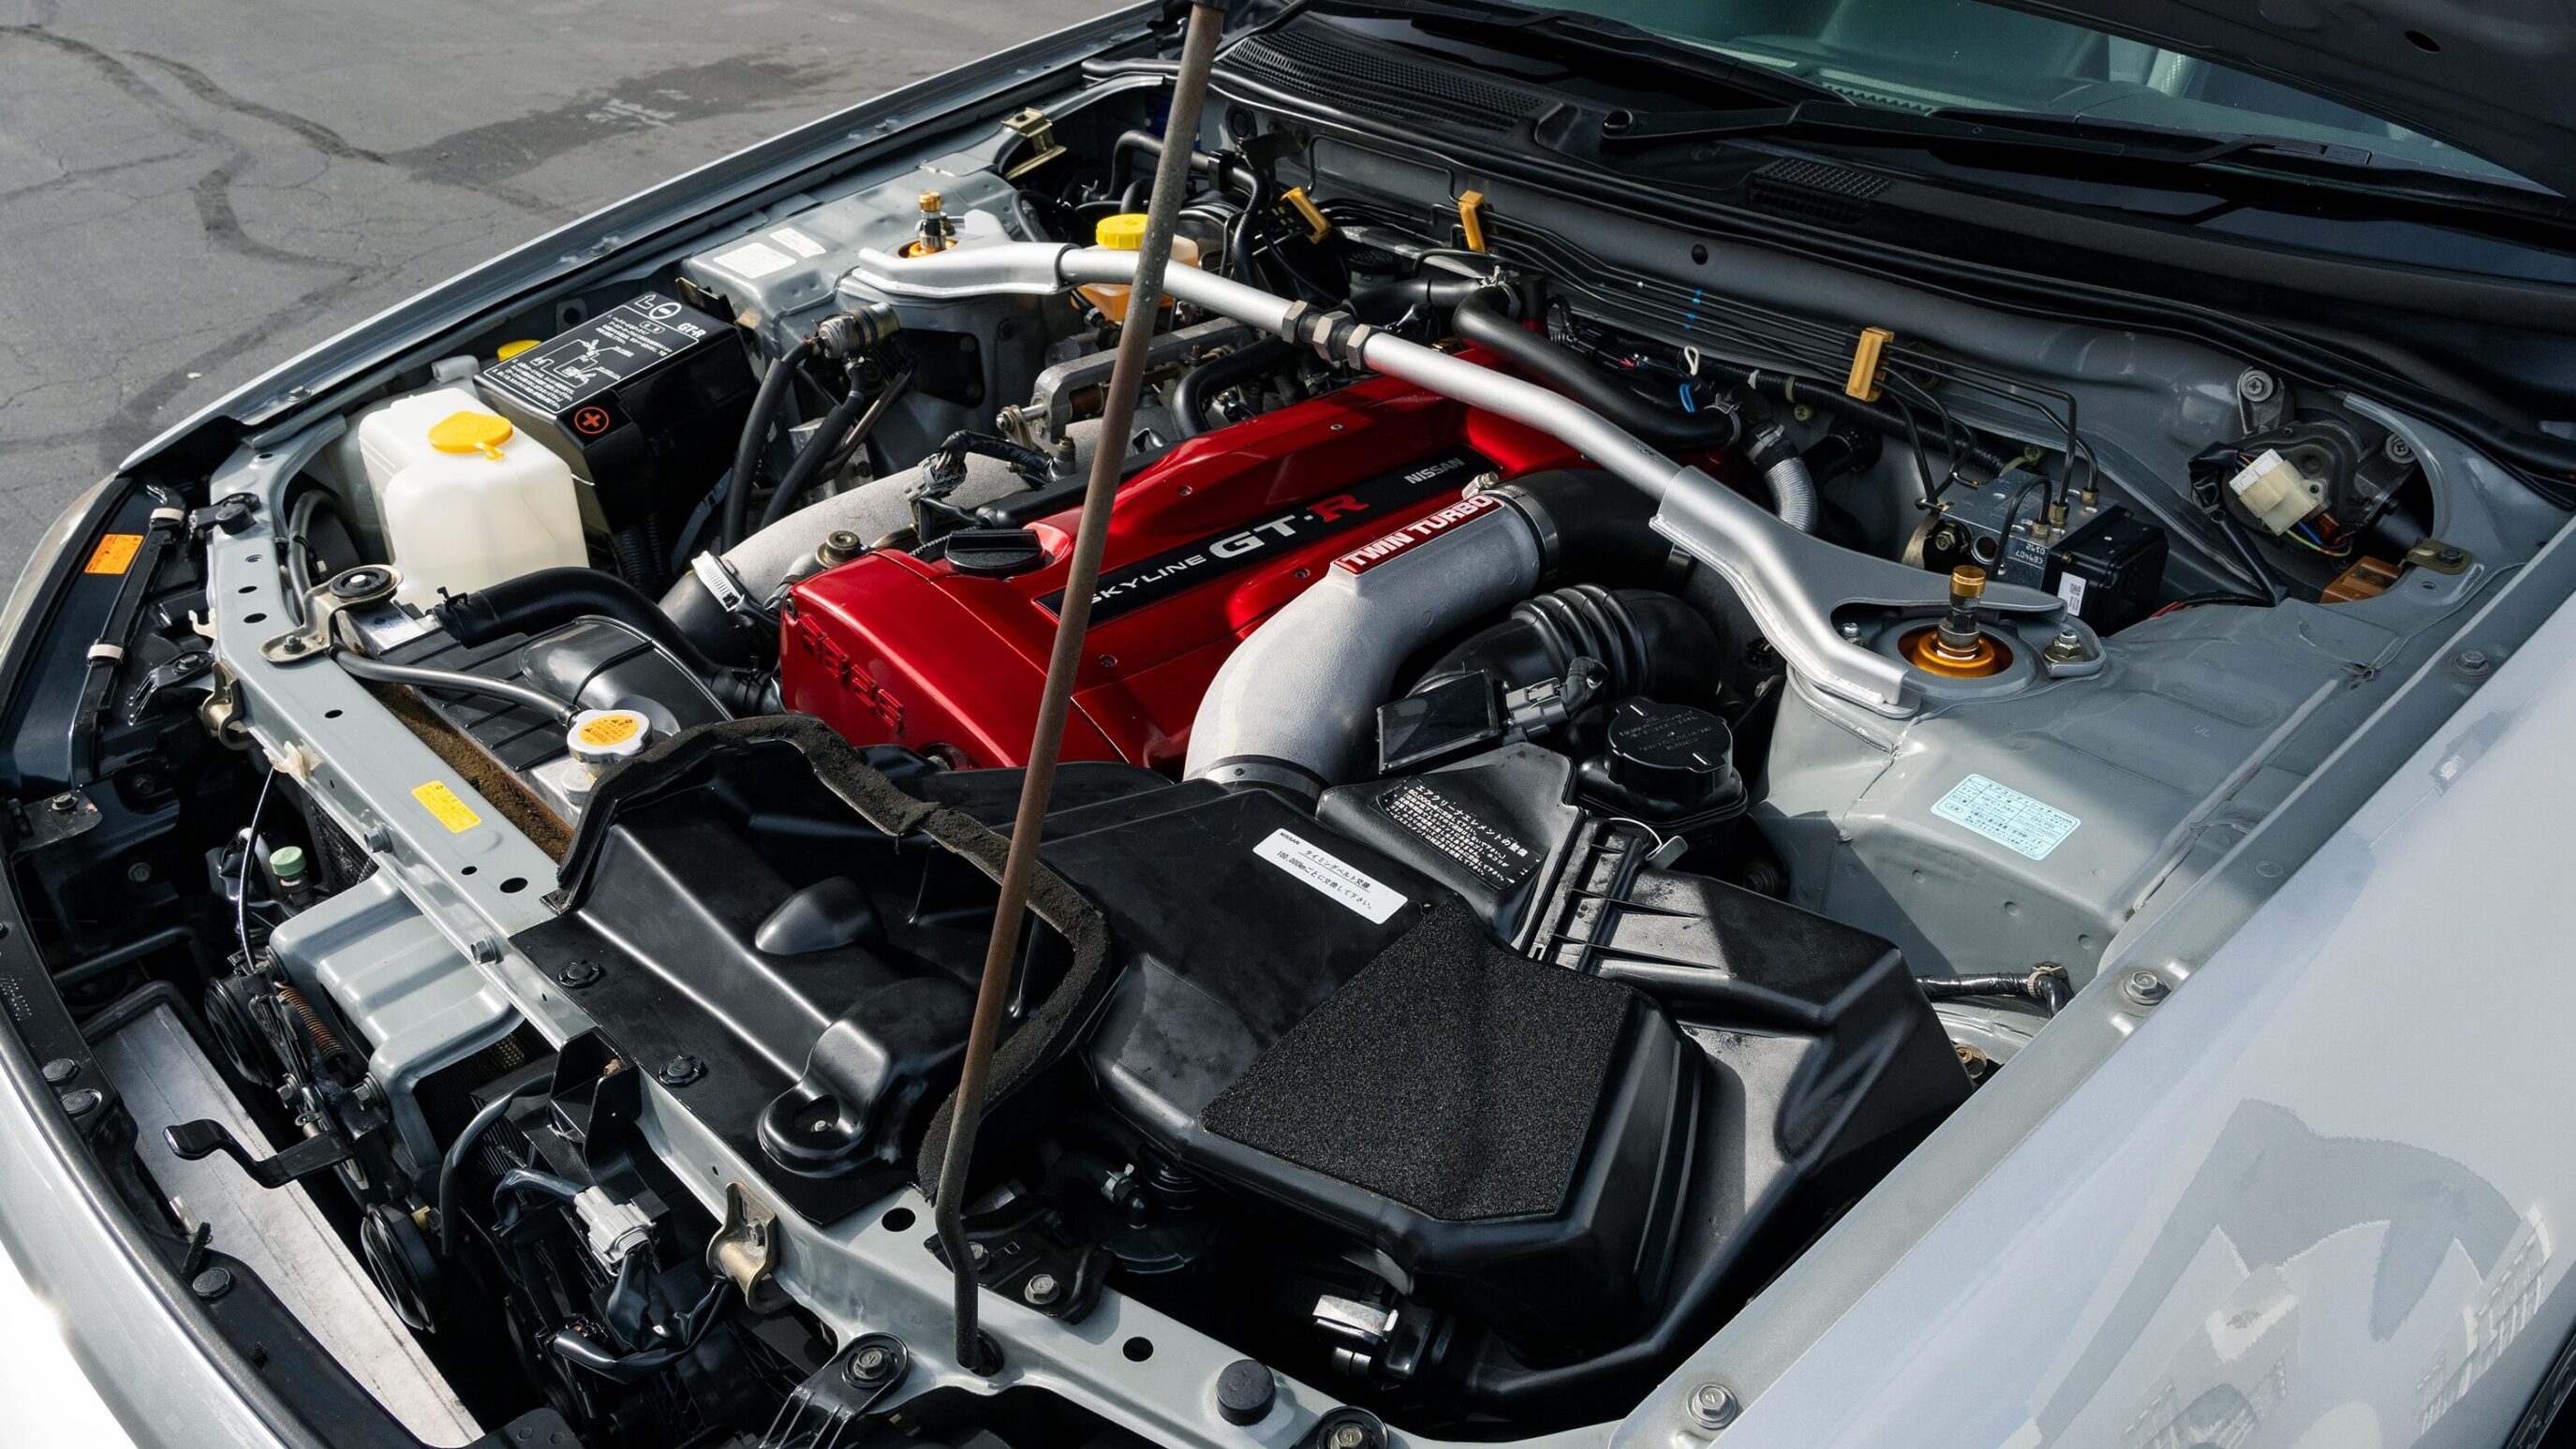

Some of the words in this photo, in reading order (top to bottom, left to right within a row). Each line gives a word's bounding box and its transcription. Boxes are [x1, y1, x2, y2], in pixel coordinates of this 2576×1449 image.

[677, 322, 706, 337] GT-R
[1404, 457, 1465, 484] NISSAN
[1344, 531, 1415, 567] TWIN
[1409, 495, 1494, 536] TURBO
[1091, 554, 1207, 604] SKYLINE
[1278, 832, 1300, 845] NISSAN
[1415, 785, 1529, 857] エアクリーナエレメントの整備
[1303, 849, 1372, 889] タイミングベルト交換
